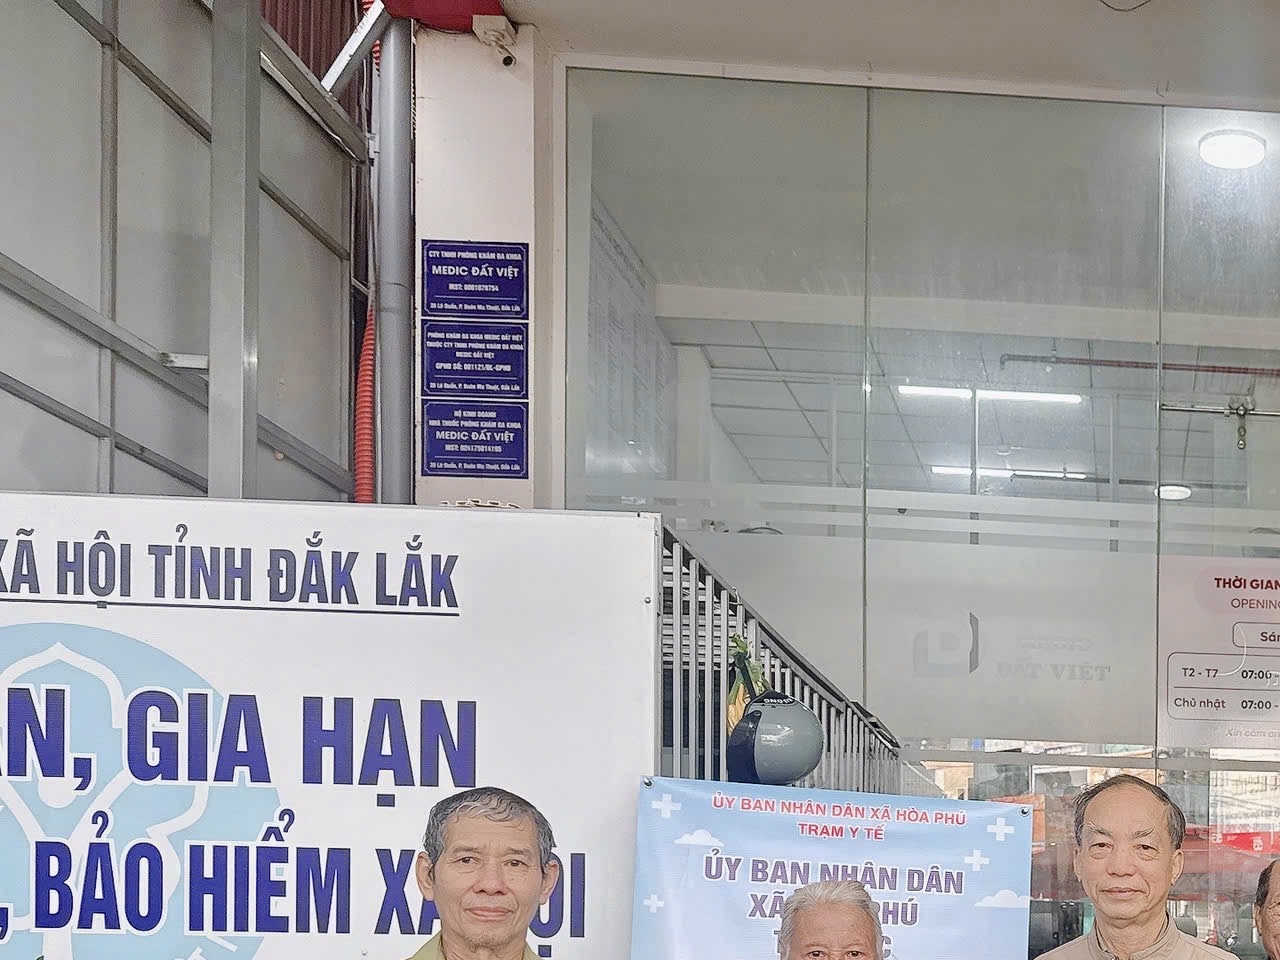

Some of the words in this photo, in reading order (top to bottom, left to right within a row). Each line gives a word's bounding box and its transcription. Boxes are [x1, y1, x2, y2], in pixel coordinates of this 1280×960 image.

[431, 265, 469, 276] MEDIC
[471, 263, 494, 277] ĐẤT
[496, 265, 519, 280] VIỆT
[435, 430, 469, 440] MEDIC
[471, 428, 491, 440] ĐẤT
[493, 430, 515, 443] VIỆT
[0, 528, 41, 595] Ã
[57, 530, 131, 609] HỘI
[148, 523, 252, 601] TỈNH
[267, 531, 359, 605] ĐẮK
[376, 534, 459, 608] LẮK
[1214, 576, 1247, 589] THỜI
[1181, 667, 1195, 678] T2
[1205, 668, 1219, 679] T7
[1241, 670, 1272, 680] 07:00
[1174, 696, 1197, 708] Chủ
[1199, 697, 1227, 709] nhật
[1241, 700, 1272, 710] 07:00
[0, 687, 93, 791] N,
[127, 689, 271, 783] GIA
[302, 696, 478, 807] HẠN
[713, 791, 736, 809] ỦY
[741, 798, 776, 812] BAN
[781, 799, 827, 817] NHÂN
[832, 804, 865, 819] DÂN
[870, 806, 892, 821] XÃ
[896, 808, 929, 823] HÒA
[934, 810, 967, 825] PHÚ
[799, 823, 844, 838] TRẠM
[849, 827, 859, 839] Y
[864, 823, 886, 840] TẾ
[35, 810, 164, 931] BẢO
[188, 808, 350, 935] HIỂM
[705, 848, 742, 881] ỦY
[751, 859, 810, 885] BAN
[820, 860, 897, 890] NHÂN
[907, 865, 964, 894] DÂN
[876, 899, 918, 926] HÚ
